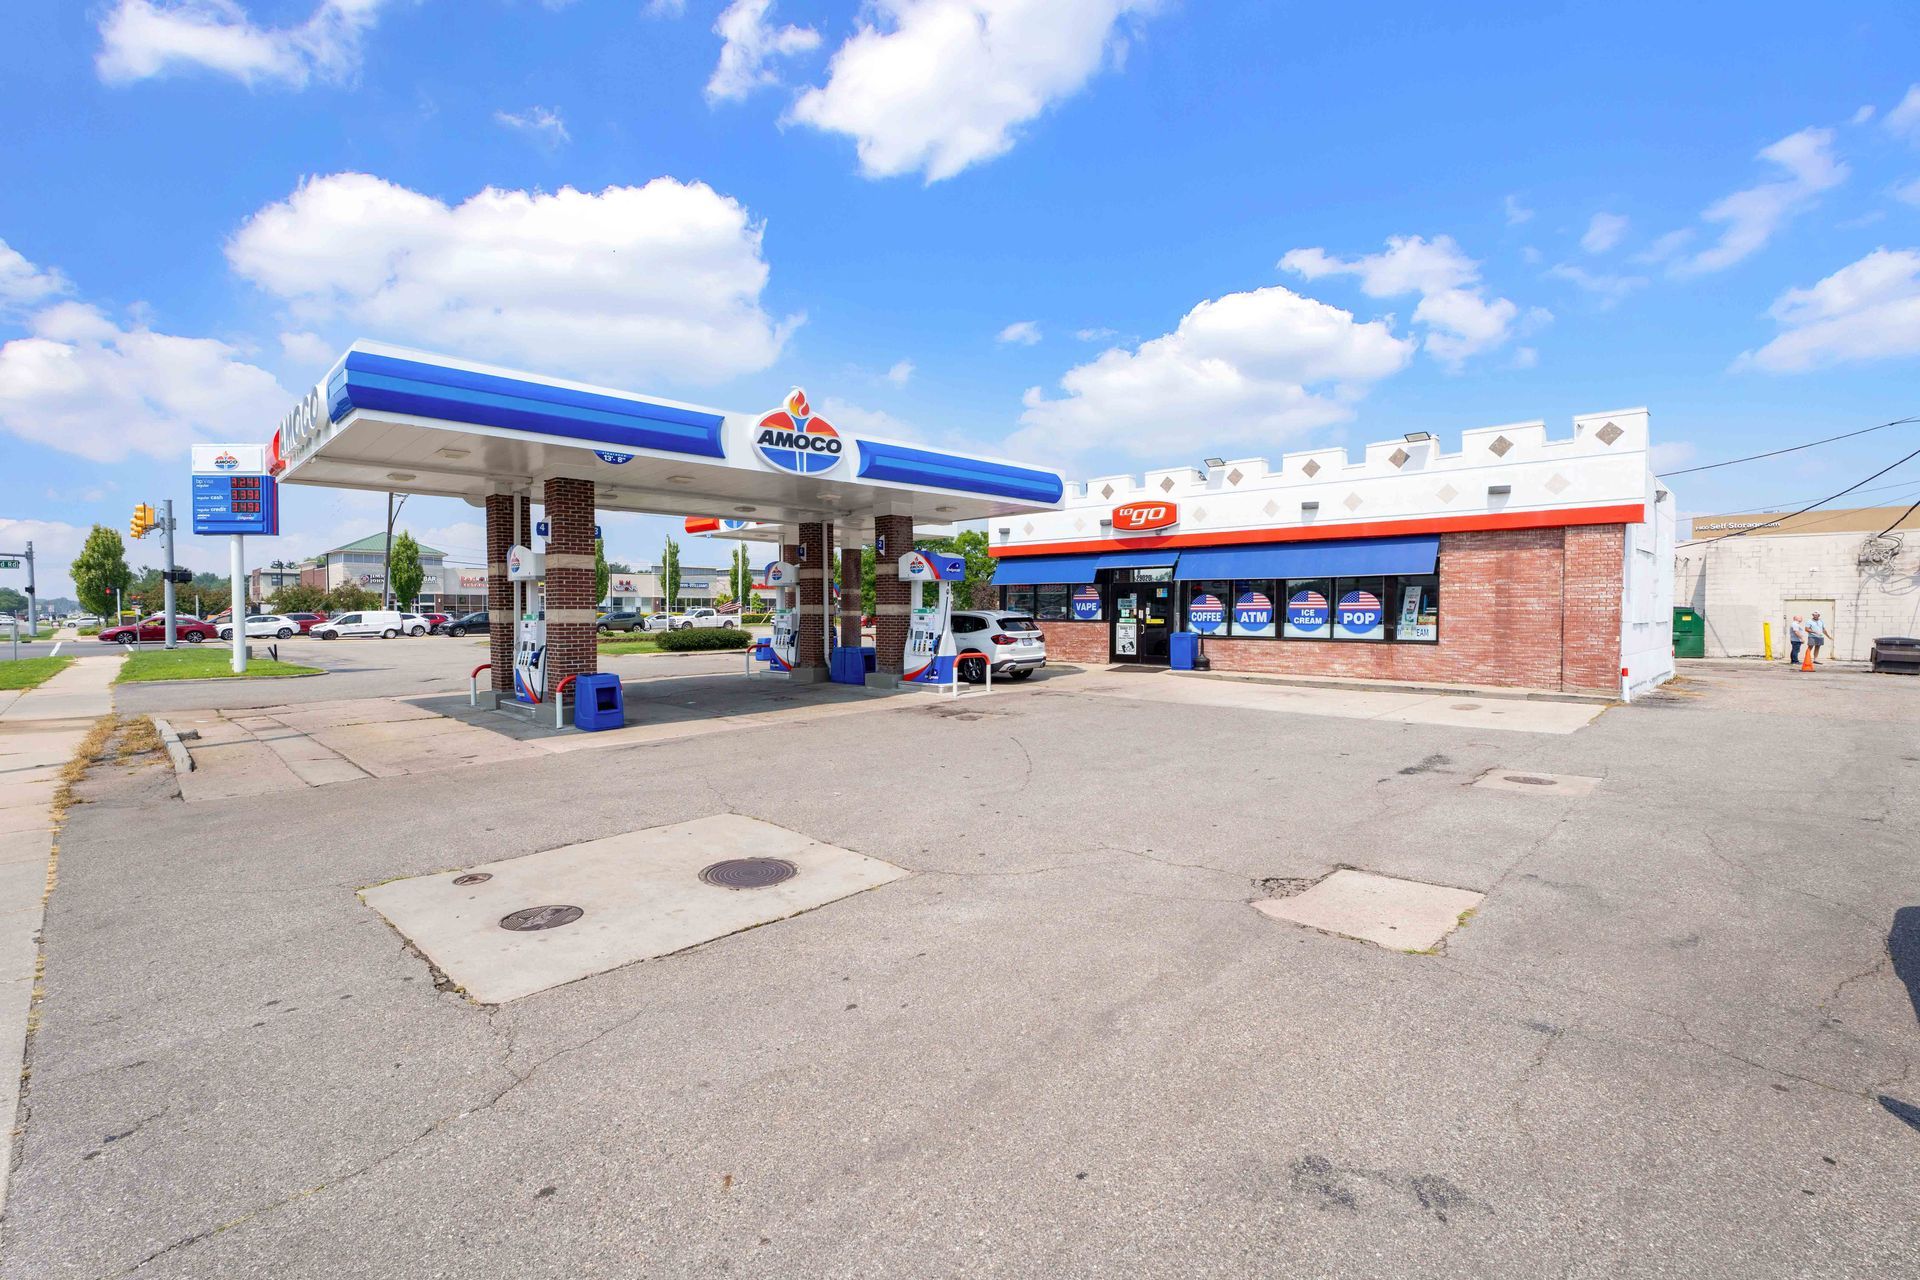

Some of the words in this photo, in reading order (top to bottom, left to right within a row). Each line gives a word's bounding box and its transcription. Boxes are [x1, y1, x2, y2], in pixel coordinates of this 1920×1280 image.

[280, 386, 318, 458] AMOCO
[757, 429, 842, 454] AMOCO
[1119, 508, 1133, 516] to
[1130, 507, 1166, 526] go
[539, 523, 545, 531] 4
[878, 539, 883, 547] 2
[1075, 602, 1097, 611] VAPE
[1191, 612, 1222, 622] COFFEE
[1240, 611, 1267, 623] ATM
[1301, 609, 1315, 617] ICE
[1293, 617, 1323, 625] CREAM
[1343, 612, 1375, 625] POP
